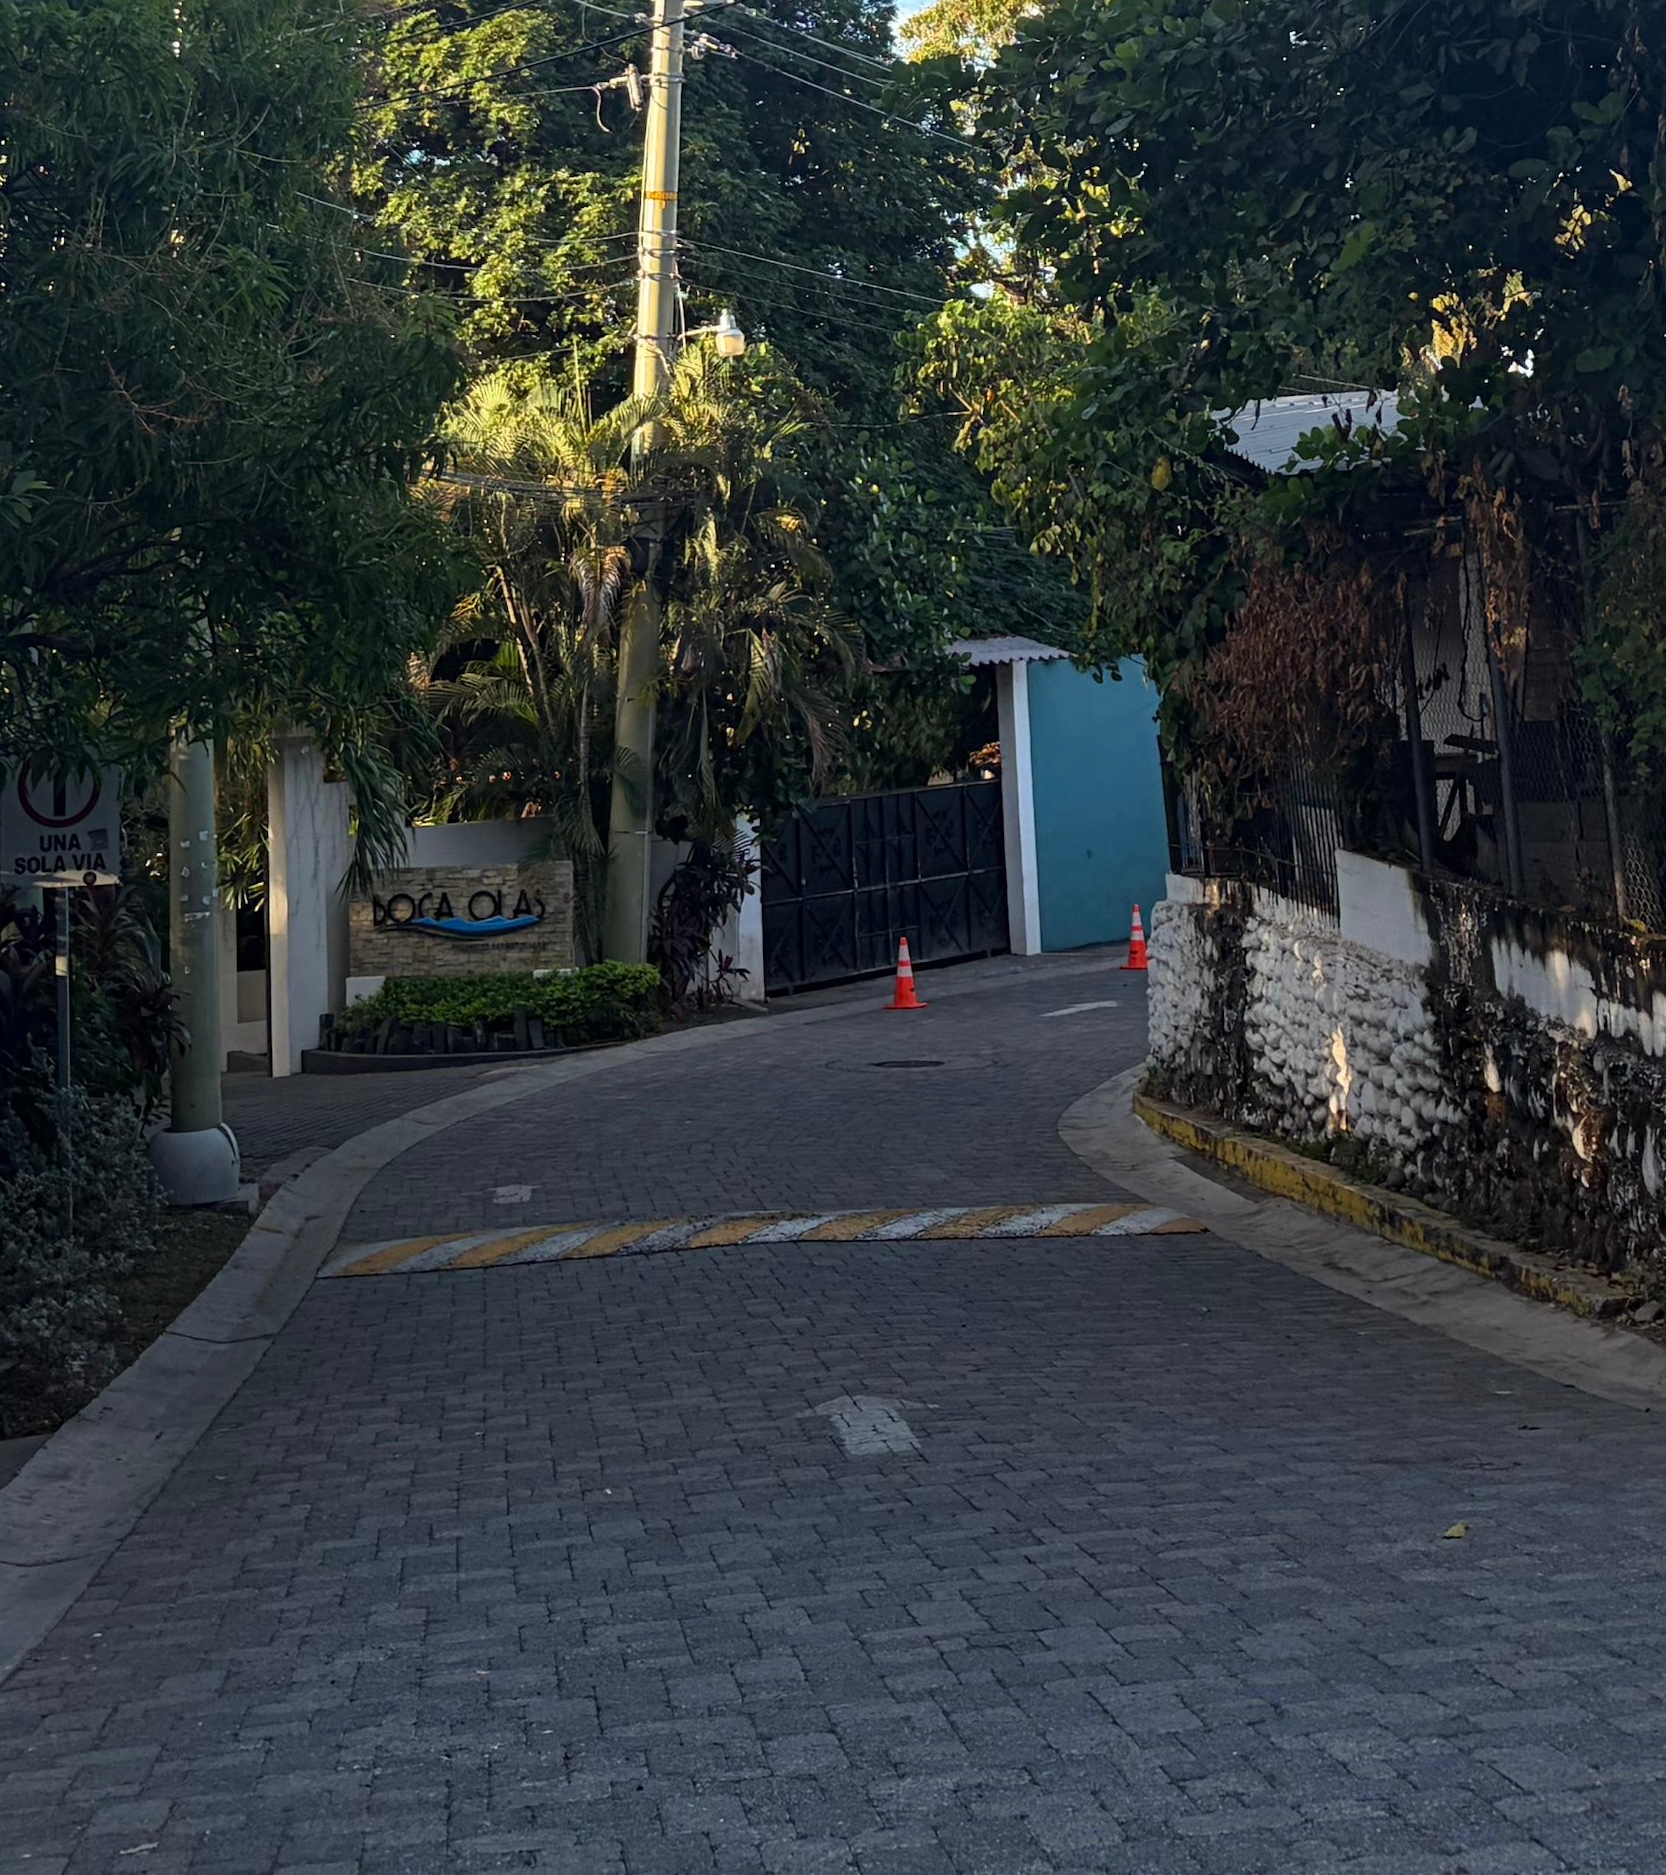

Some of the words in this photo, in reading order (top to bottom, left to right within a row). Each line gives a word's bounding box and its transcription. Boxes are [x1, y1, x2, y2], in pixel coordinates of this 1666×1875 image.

[39, 833, 81, 851] UNA
[14, 856, 66, 874] SOLA
[72, 853, 107, 870] VIA
